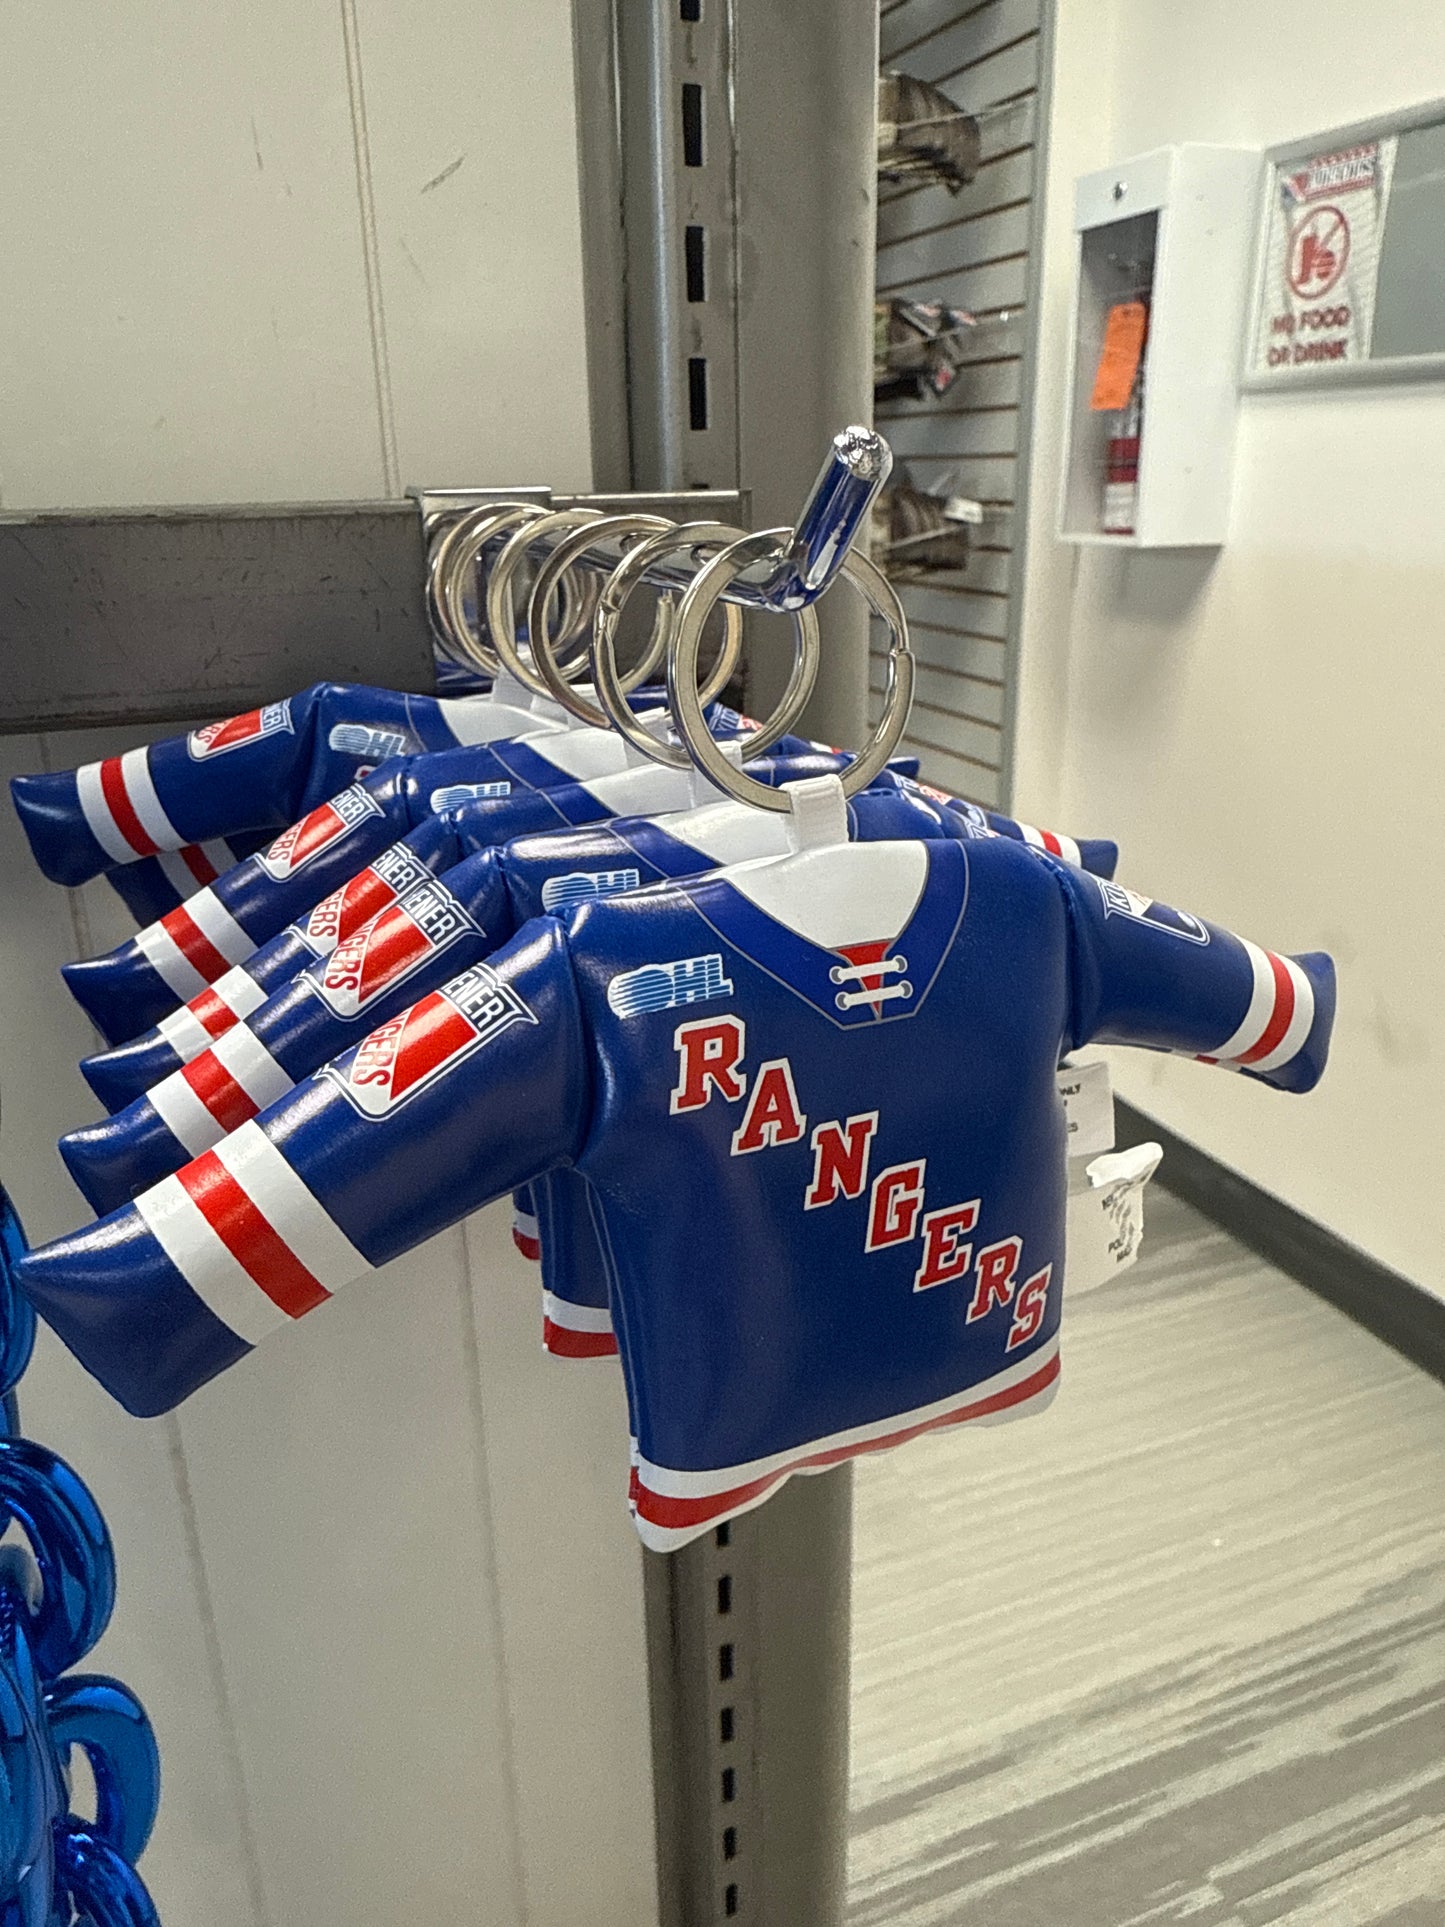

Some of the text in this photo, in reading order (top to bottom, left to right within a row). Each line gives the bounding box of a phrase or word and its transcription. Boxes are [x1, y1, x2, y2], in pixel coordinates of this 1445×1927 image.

[440, 971, 505, 1028] ENER
[607, 953, 733, 1019] OHL
[669, 1014, 1053, 1353] RANGERS
